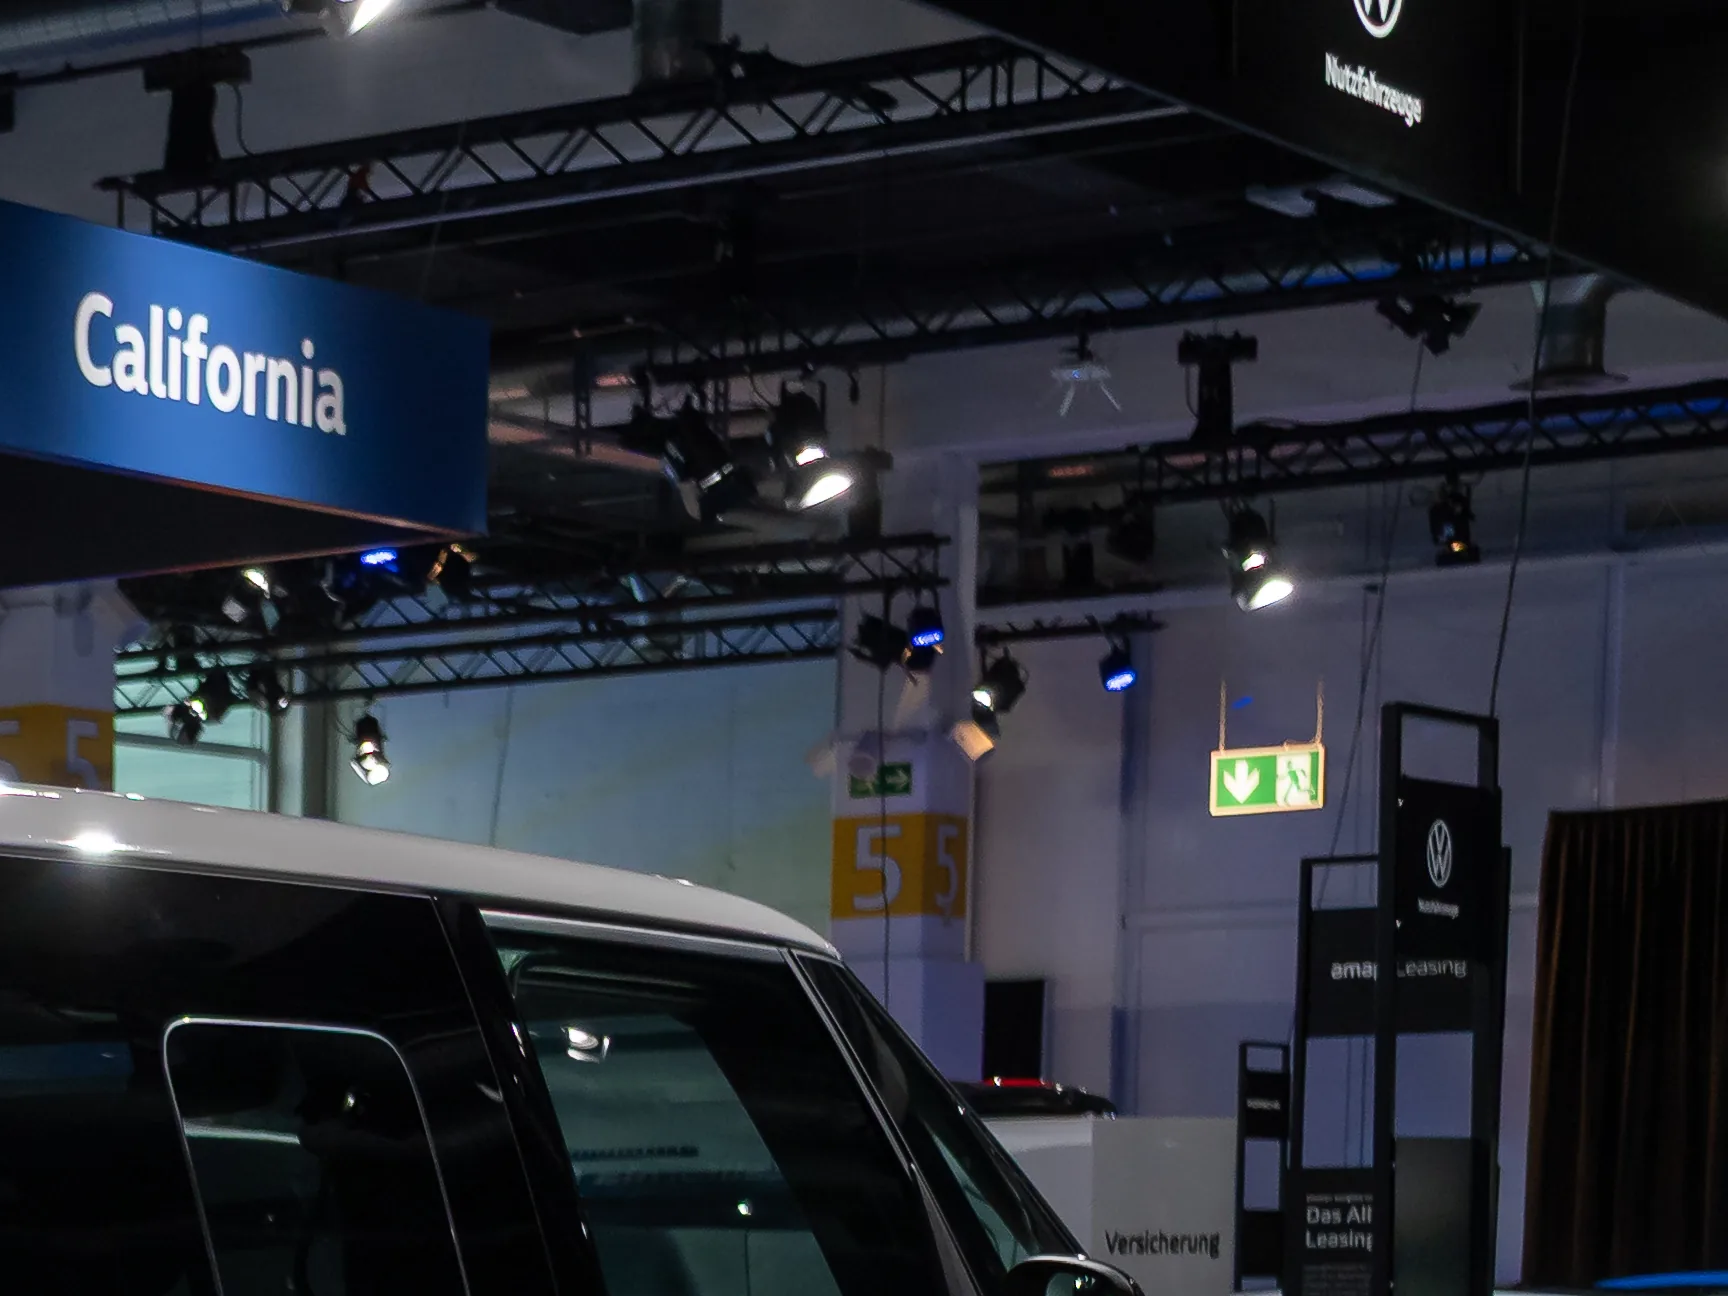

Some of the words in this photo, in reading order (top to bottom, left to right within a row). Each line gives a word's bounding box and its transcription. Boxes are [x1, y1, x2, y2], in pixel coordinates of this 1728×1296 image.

[1325, 51, 1423, 128] Nutzfahrzeuge
[74, 291, 348, 436] California
[852, 823, 903, 912] 5
[935, 824, 959, 910] 5
[1330, 960, 1378, 981] ama
[1105, 1229, 1221, 1259] Versicherung
[1306, 1207, 1342, 1224] Das
